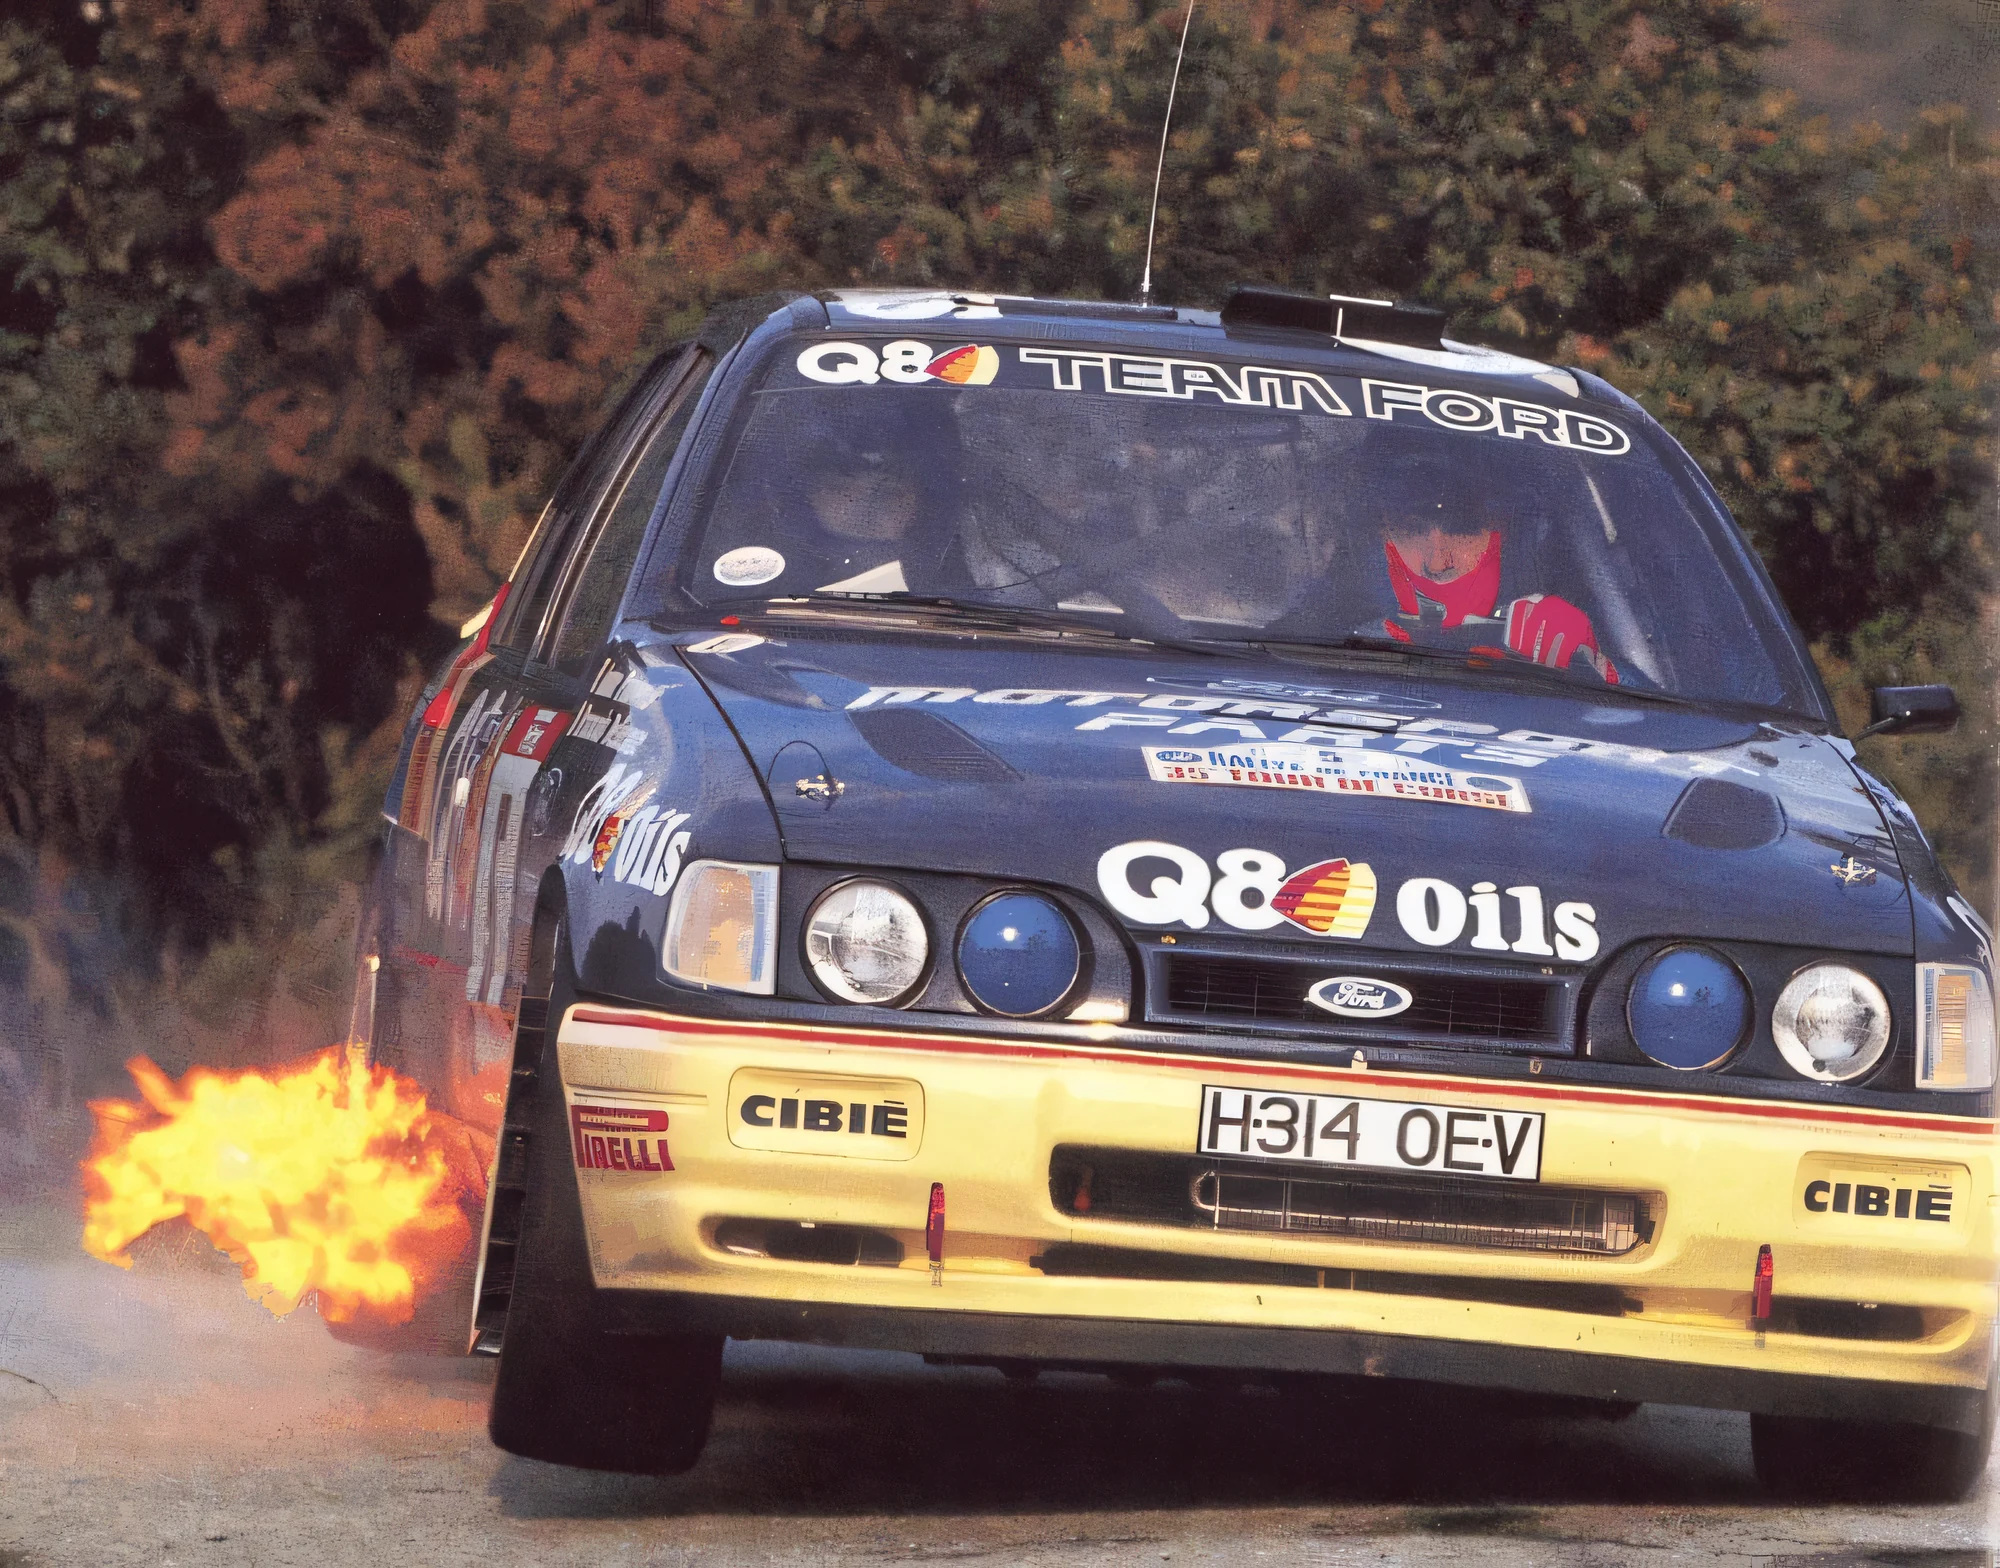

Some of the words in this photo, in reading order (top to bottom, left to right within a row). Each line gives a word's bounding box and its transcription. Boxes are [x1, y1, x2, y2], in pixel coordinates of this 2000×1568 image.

[796, 341, 934, 385] Q8
[1019, 346, 1352, 416] TEAM
[1361, 377, 1633, 456] FORD
[1097, 840, 1288, 930] Q8
[1396, 877, 1600, 962] Oils
[1332, 981, 1386, 1009] Ford
[571, 1105, 676, 1172] PIRELLI
[1206, 1091, 1361, 1161] H314
[1396, 1108, 1534, 1176] OEV
